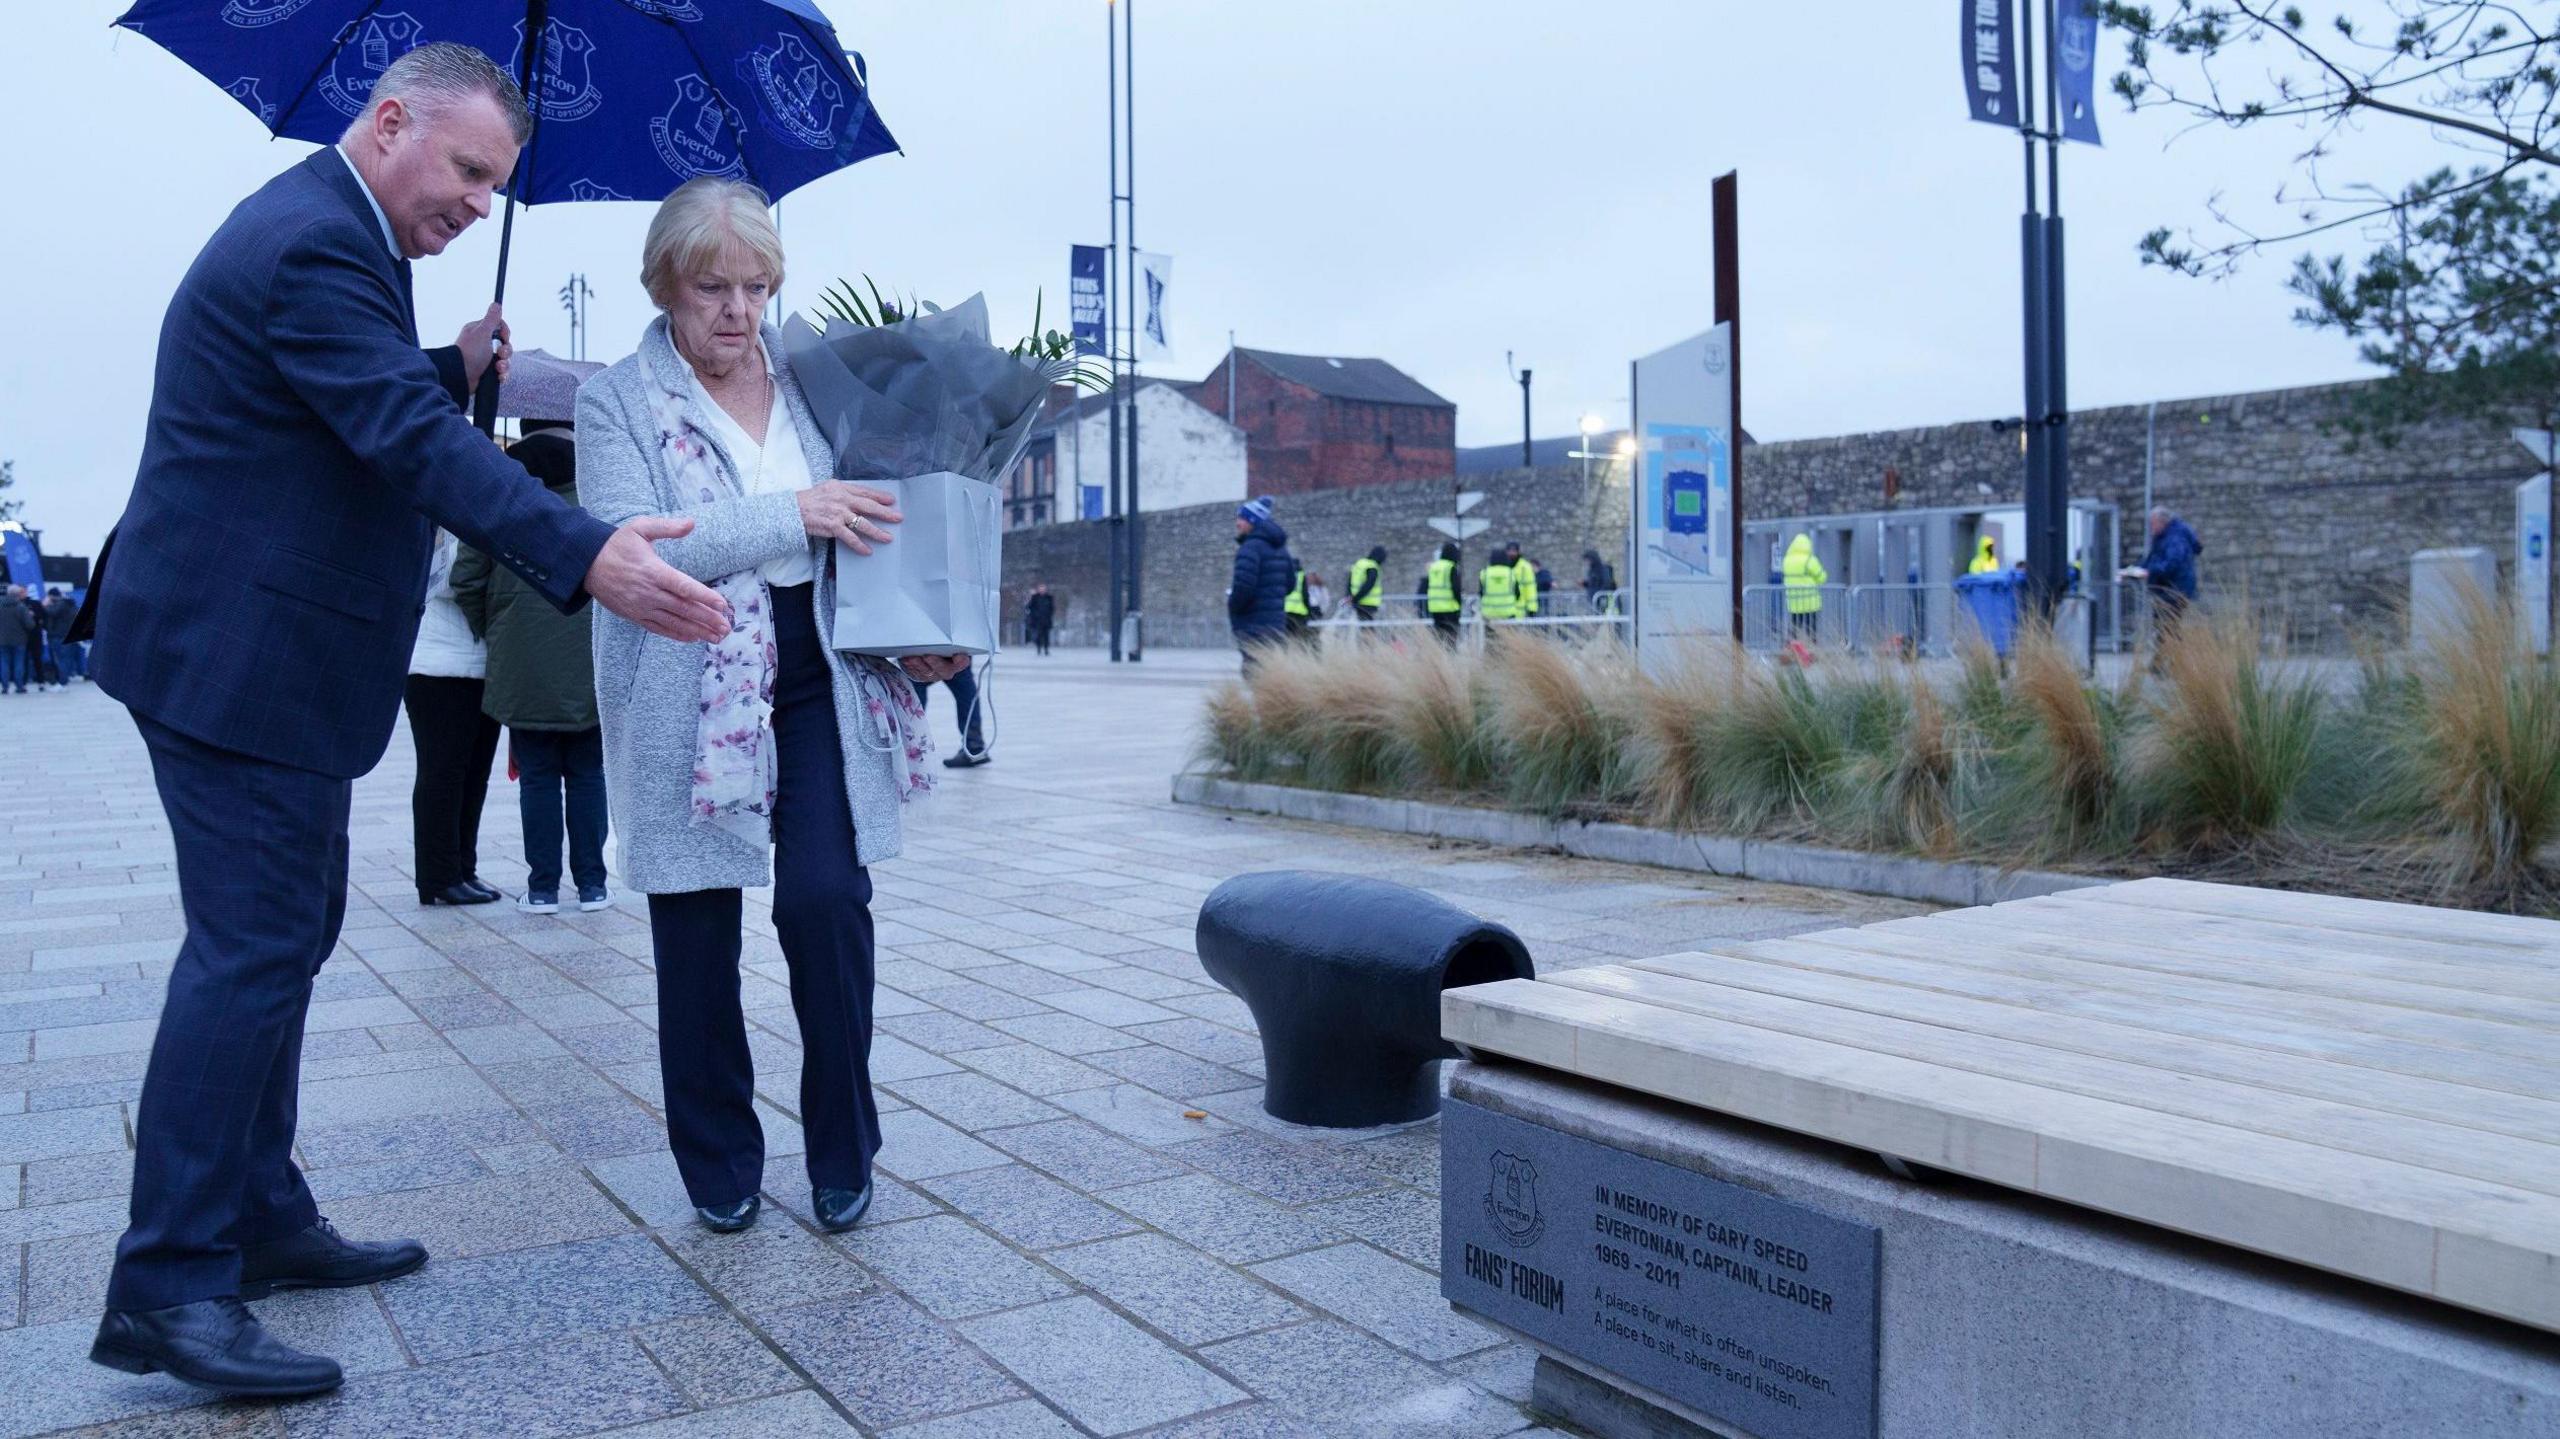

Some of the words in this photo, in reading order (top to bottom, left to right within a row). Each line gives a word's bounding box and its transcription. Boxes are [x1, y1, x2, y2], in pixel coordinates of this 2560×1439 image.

[1975, 29, 2000, 64] THE
[774, 73, 818, 129] Everton
[1977, 65, 2002, 92] UP
[673, 128, 727, 165] Everton
[1497, 1200, 1530, 1222] Everton
[1596, 1185, 1610, 1205] IN
[1613, 1190, 1678, 1228] MEMORY
[1682, 1214, 1702, 1236] OF
[1707, 1221, 1749, 1252] GARY
[1753, 1237, 1808, 1272] SPEED
[1465, 1242, 1507, 1289] FANS'
[1511, 1260, 1564, 1316] FORUM
[1595, 1243, 1630, 1270] 1969
[1645, 1261, 1680, 1290] 2011
[1596, 1214, 1688, 1267] EVERTONIAN,
[1693, 1247, 1763, 1293] CAPTAIN,
[1767, 1273, 1833, 1314] LEADER
[1594, 1286, 1603, 1304] A
[1606, 1291, 1638, 1316] place
[1642, 1305, 1661, 1326] for
[1664, 1317, 1698, 1341] what
[1701, 1327, 1713, 1347] is
[1717, 1337, 1755, 1362] often
[1759, 1353, 1836, 1397] unspoken.
[1594, 1311, 1602, 1328] A
[1605, 1317, 1638, 1342] place
[1641, 1329, 1655, 1349] to
[1659, 1339, 1681, 1361] sit,
[1684, 1349, 1721, 1377] share
[1725, 1368, 1752, 1389] and
[1756, 1376, 1802, 1411] listen.
